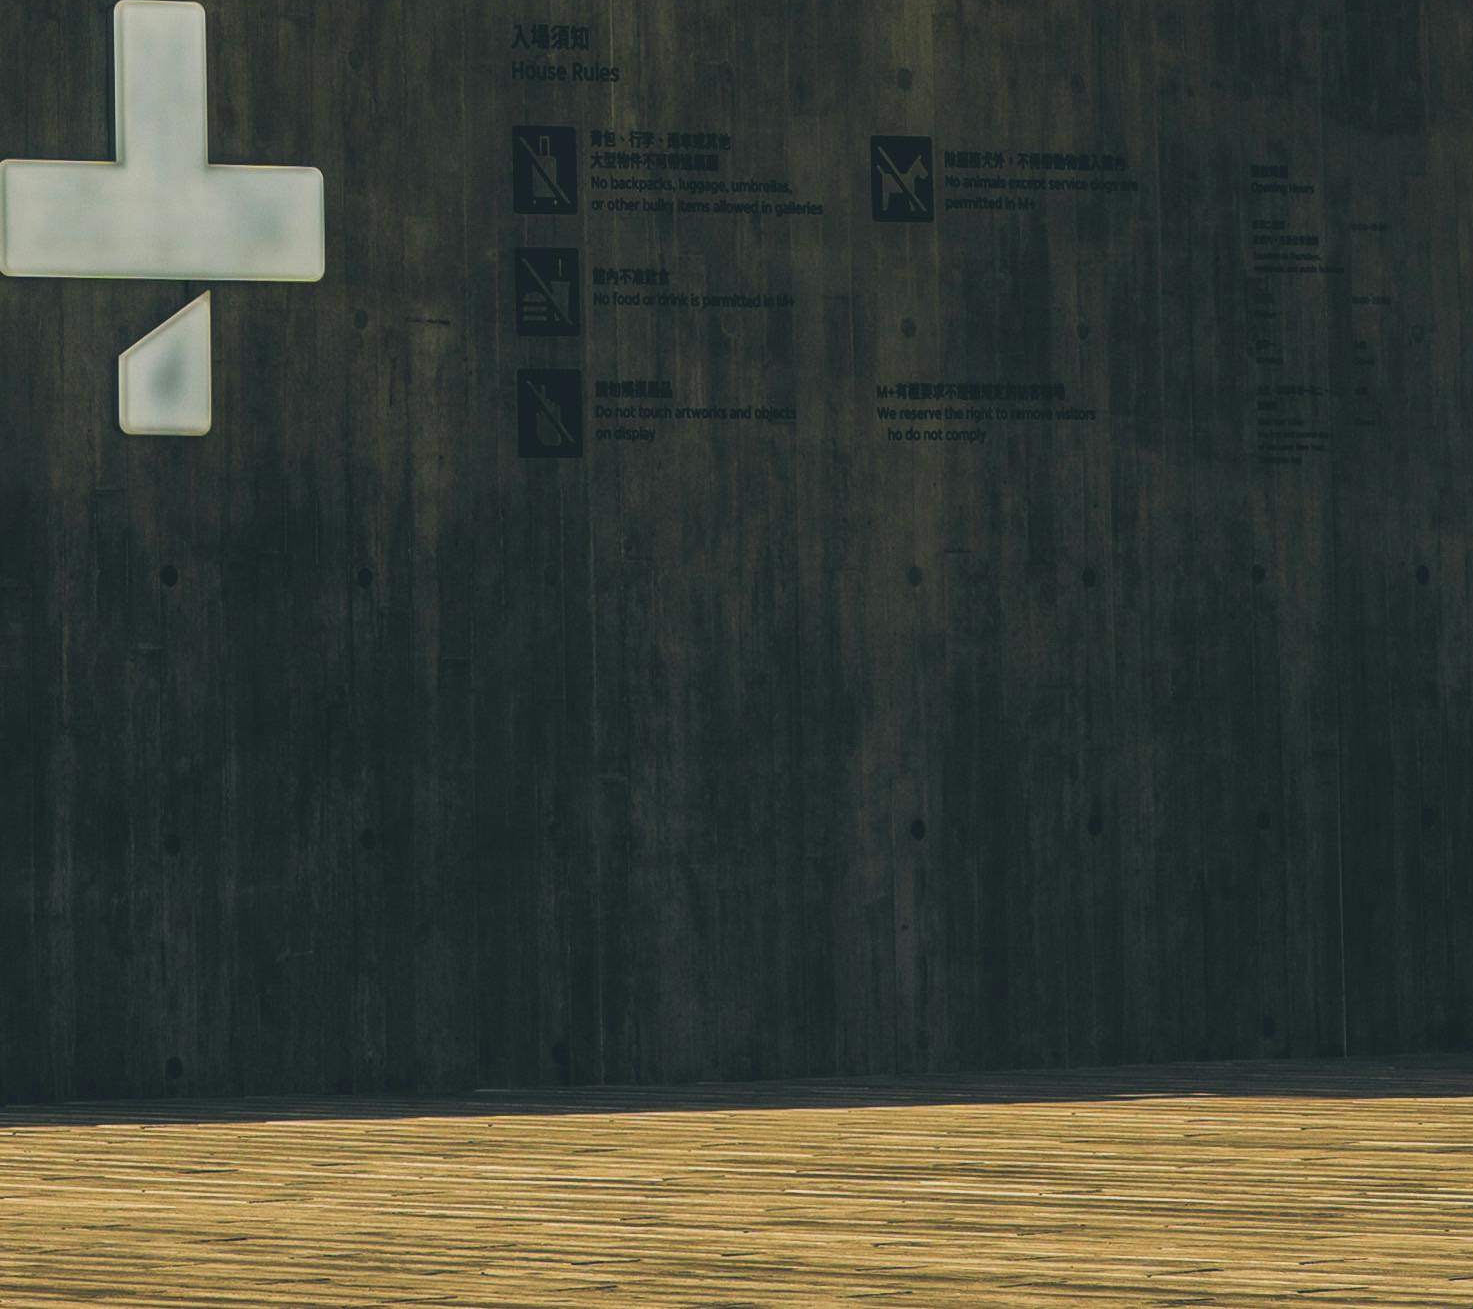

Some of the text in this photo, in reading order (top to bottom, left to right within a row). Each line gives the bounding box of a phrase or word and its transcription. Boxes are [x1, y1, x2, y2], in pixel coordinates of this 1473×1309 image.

[511, 25, 589, 51] 入場須知
[511, 60, 620, 83] House Rules
[591, 175, 793, 195] No backpacks, luggage, umbrellas,
[945, 175, 961, 188] No
[963, 175, 1006, 189] animals
[1009, 178, 1046, 191] except
[1048, 177, 1088, 191] service
[1250, 182, 1315, 196] Opening Hours
[591, 200, 605, 212] or
[608, 198, 639, 212] other
[678, 200, 710, 213] items
[712, 199, 759, 214] allowed
[761, 200, 773, 214] in
[774, 201, 824, 218] galleries
[945, 197, 1035, 212] permitted in M+
[593, 293, 609, 306] No
[612, 292, 640, 306] food
[658, 292, 689, 306] drink
[691, 294, 700, 307] is
[702, 293, 761, 309] permitted
[764, 295, 774, 307] in
[595, 405, 797, 423] Do not touch artworks and objects
[877, 407, 1097, 423] We reserve the right to remove visitors
[597, 426, 656, 443] on display
[905, 428, 921, 441] do
[924, 428, 944, 441] not
[945, 428, 987, 444] comply
